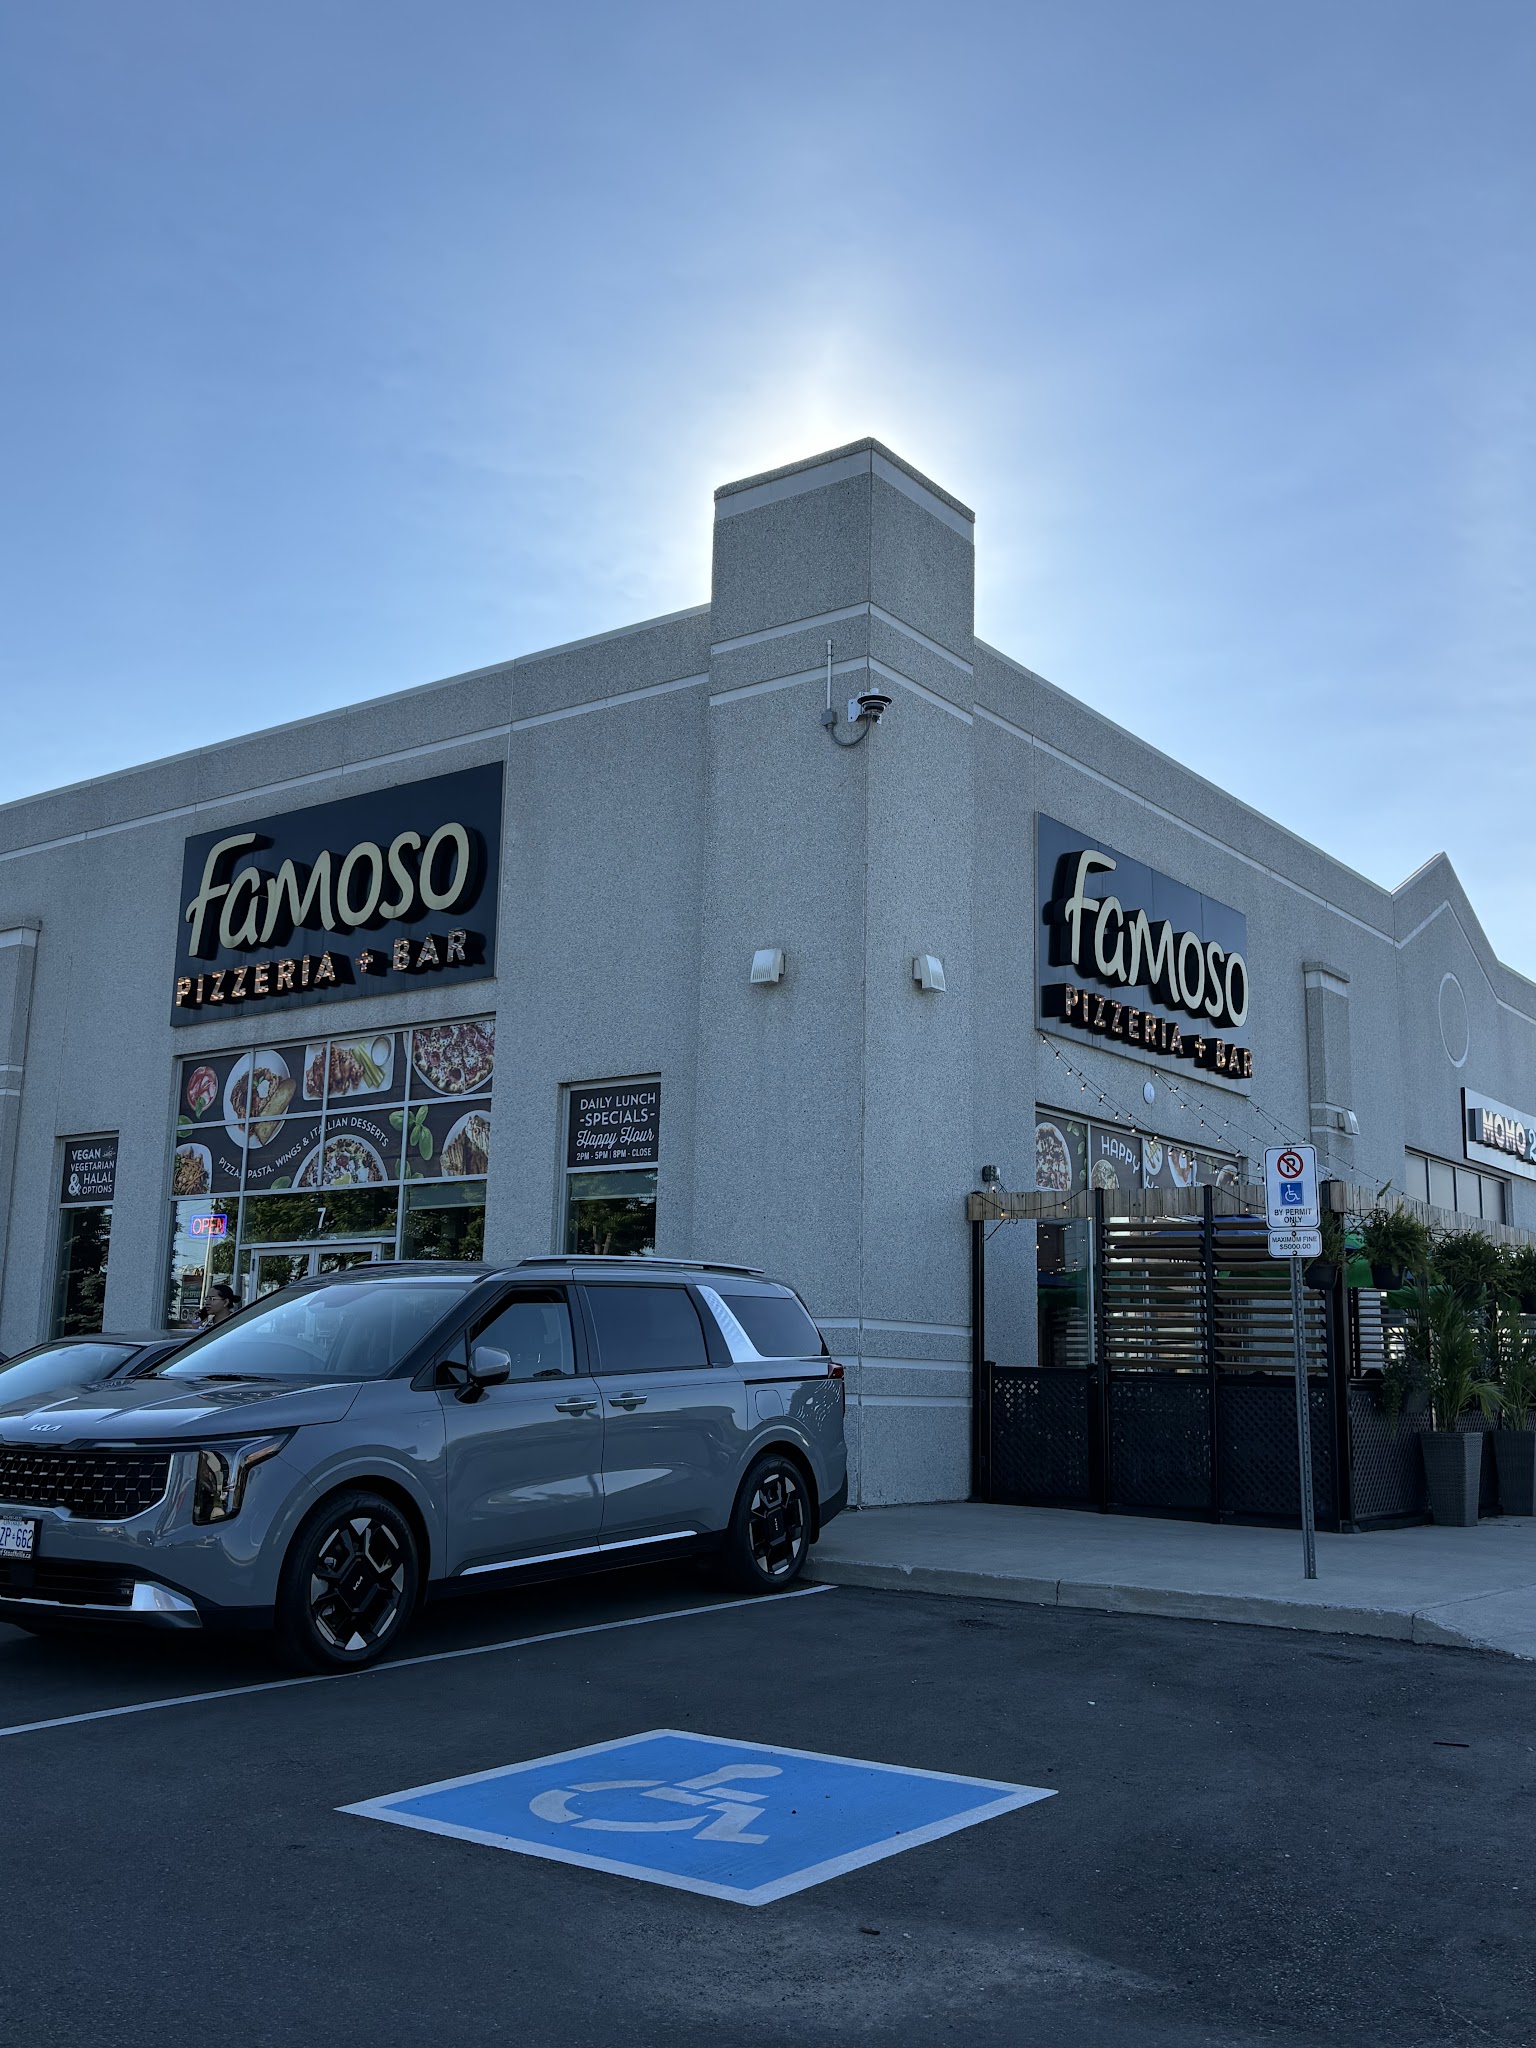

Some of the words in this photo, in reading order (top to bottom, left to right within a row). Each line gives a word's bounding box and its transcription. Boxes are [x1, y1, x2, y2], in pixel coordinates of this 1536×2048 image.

[176, 951, 335, 1007] PIZZERIA
[392, 928, 467, 971] BAR
[1065, 983, 1183, 1055] PIZZERIA
[1216, 1038, 1253, 1077] BAR
[580, 1096, 612, 1110] DAILY
[616, 1092, 656, 1107] LUNCH
[576, 1130, 618, 1150] Happy
[620, 1126, 654, 1146] Hour
[1483, 1108, 1526, 1156] MOMO
[275, 1143, 302, 1168] WINGS
[302, 1137, 310, 1146] &
[350, 1117, 389, 1148] DESSERTS
[72, 1148, 101, 1160] VEGAN
[576, 1152, 590, 1160] 2PM
[594, 1150, 608, 1160] 5PM
[632, 1148, 652, 1157] CLOSE
[1101, 1135, 1141, 1174] HAPPY
[71, 1160, 114, 1172] VEGETARIAN
[68, 1173, 81, 1196] &
[82, 1184, 112, 1194] OPTIONS
[84, 1171, 112, 1184] HALAL
[316, 1208, 326, 1228] 7
[1274, 1208, 1284, 1216] BY
[1286, 1208, 1312, 1216] PERMIT
[1284, 1216, 1302, 1224] ONLY
[192, 1218, 225, 1236] OPEN
